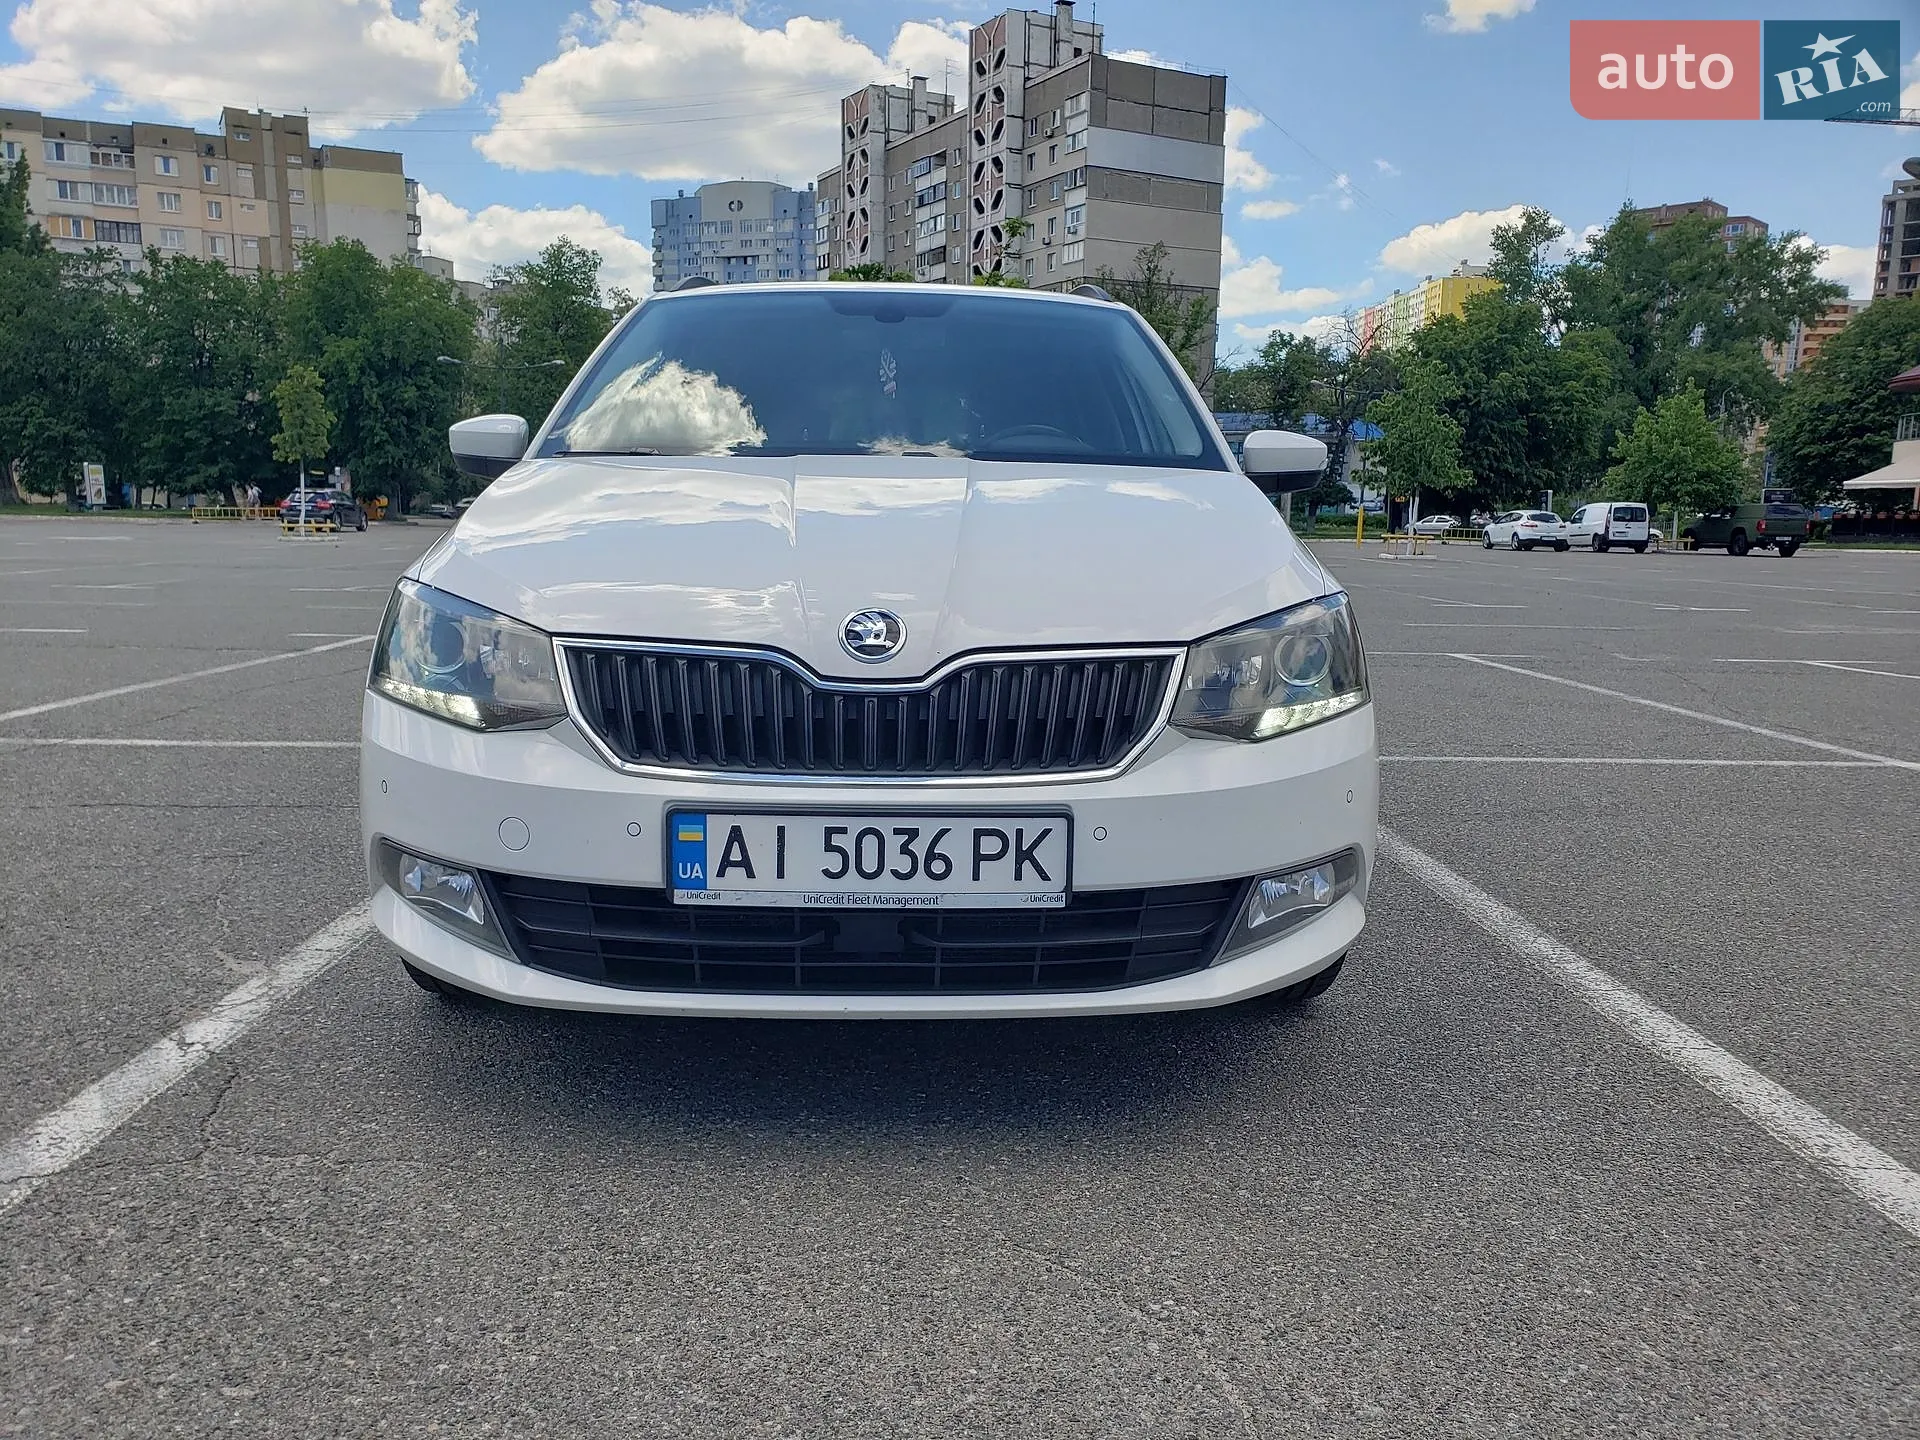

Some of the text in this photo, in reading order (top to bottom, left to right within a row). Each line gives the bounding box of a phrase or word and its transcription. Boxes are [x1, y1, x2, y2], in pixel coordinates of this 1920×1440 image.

[715, 824, 1054, 882] AI 5036 PK
[678, 862, 704, 880] UA
[686, 891, 721, 901] UniCredit
[803, 894, 940, 908] UniCredit Fleet Management
[1029, 894, 1064, 903] UniCredit
